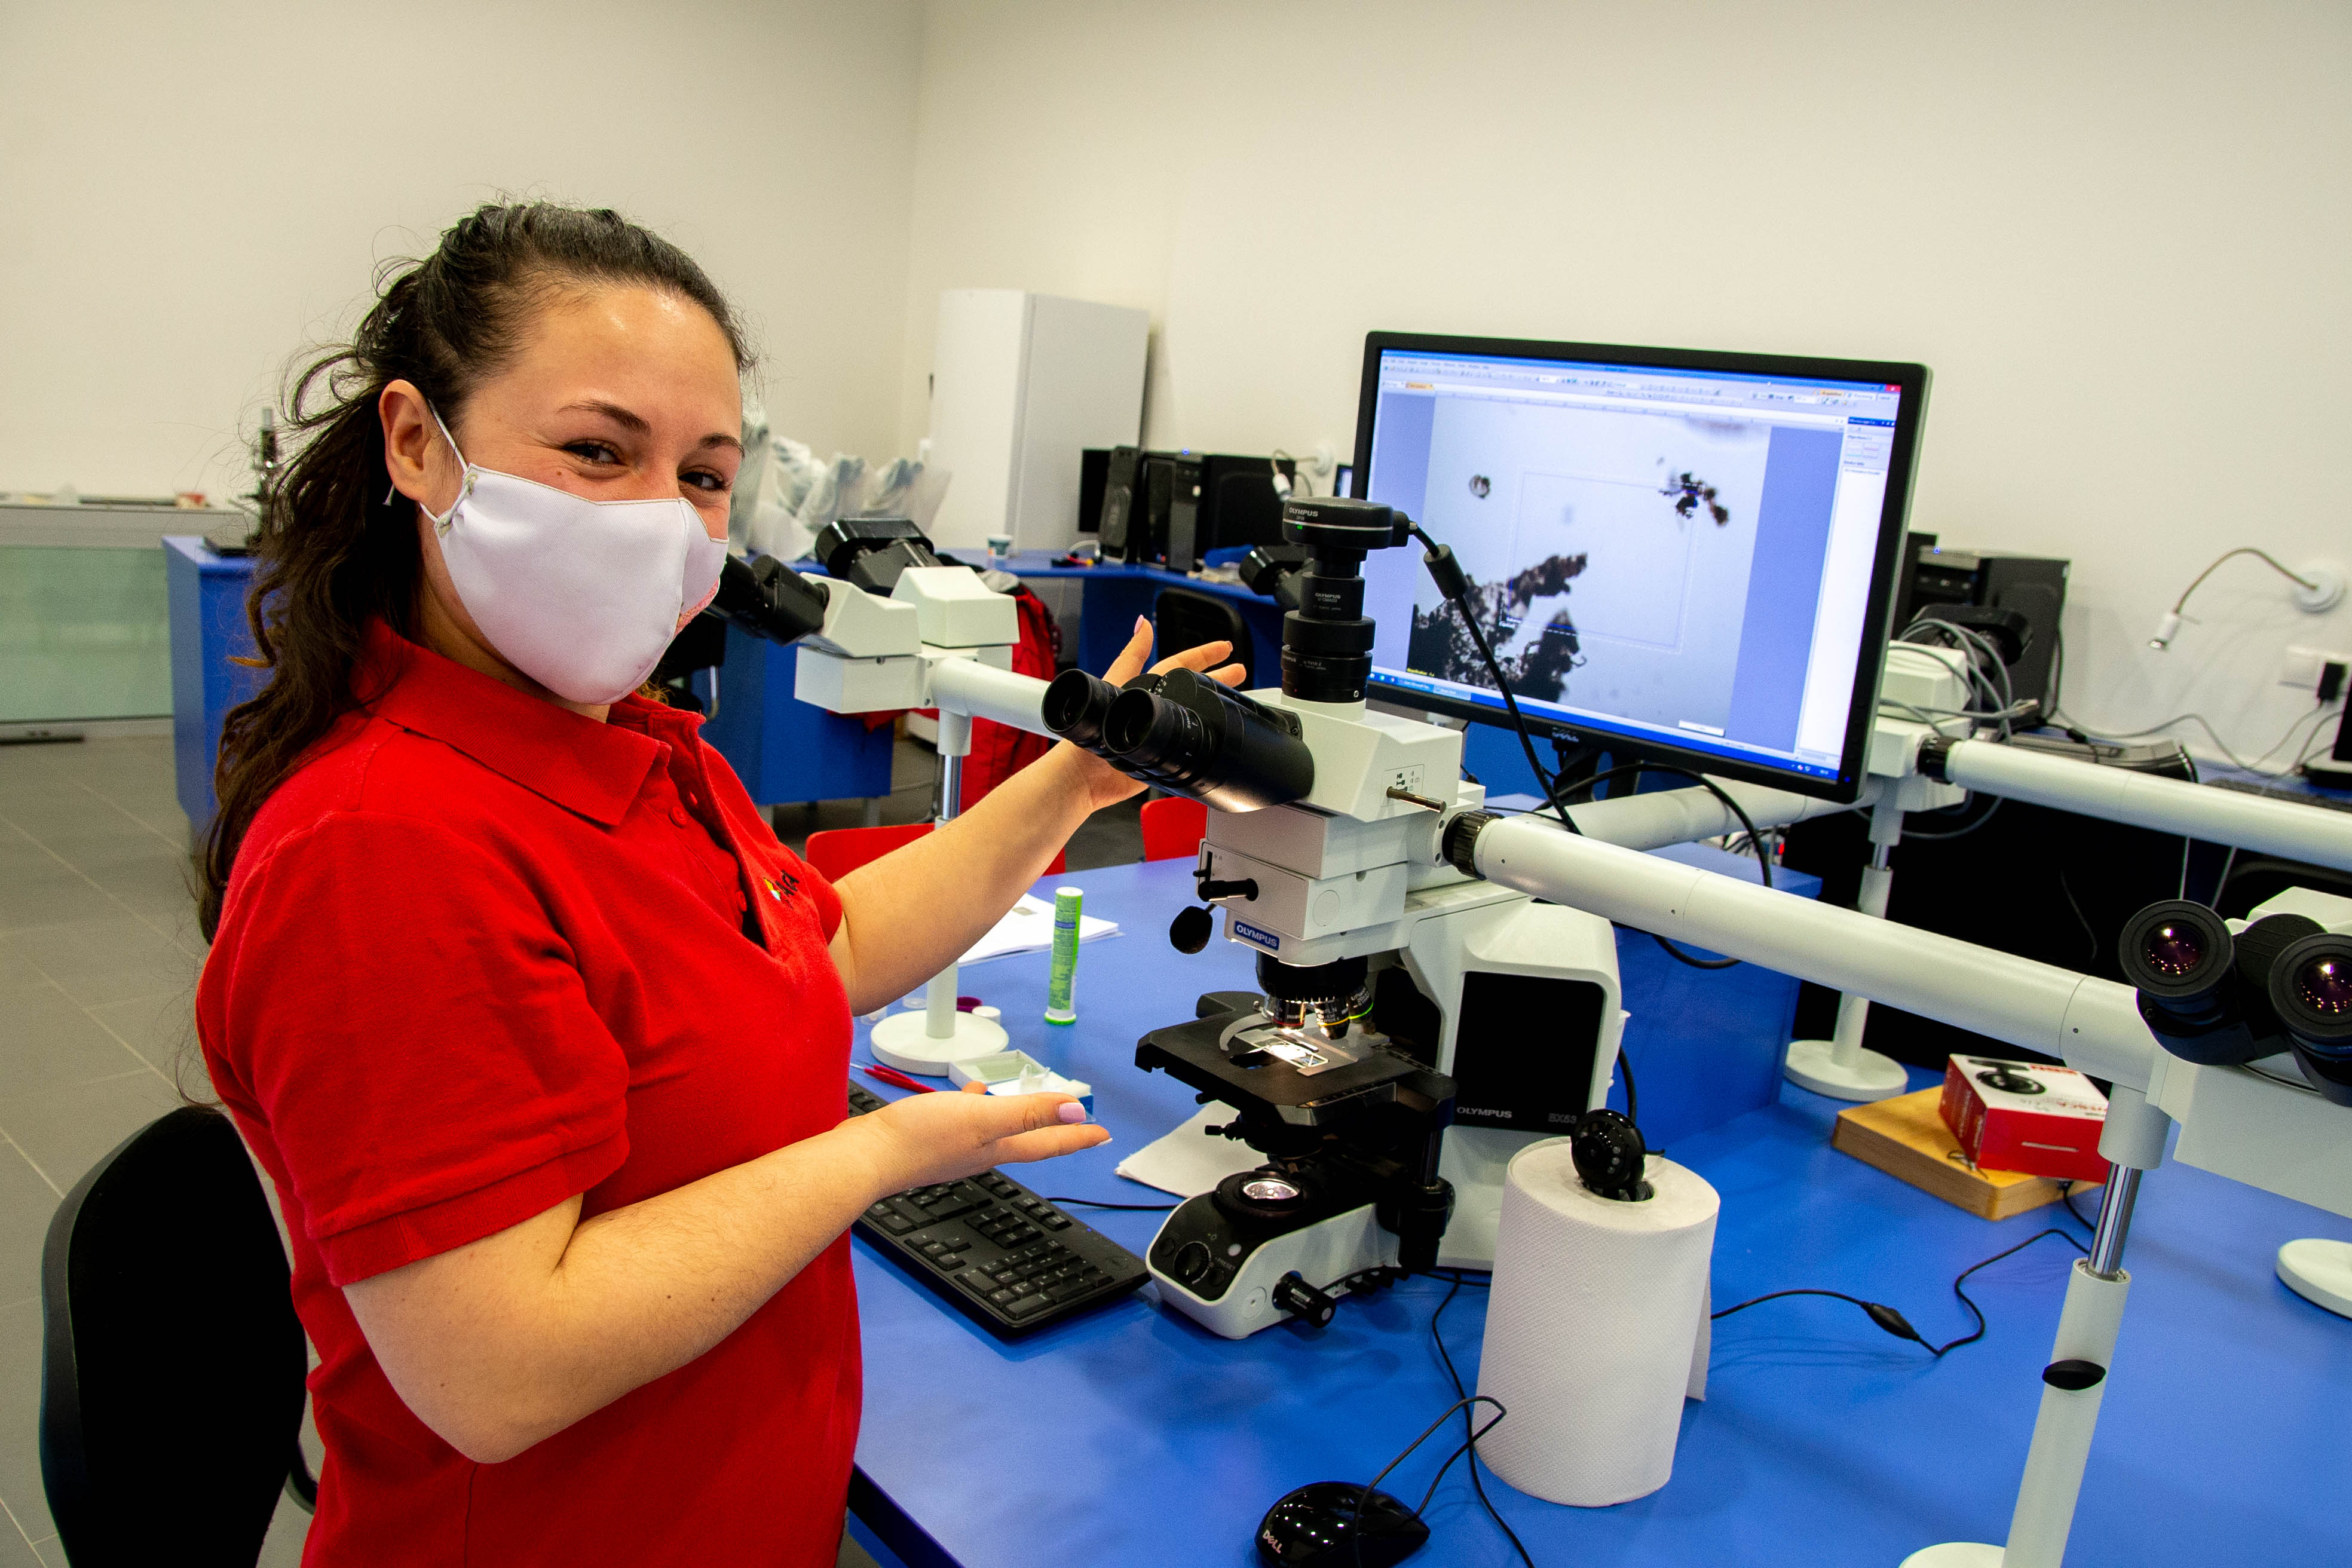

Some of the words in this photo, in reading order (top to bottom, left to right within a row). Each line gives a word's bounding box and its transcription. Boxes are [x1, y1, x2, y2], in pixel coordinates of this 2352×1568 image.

[1289, 507, 1318, 517] OLYMPUS
[1236, 924, 1277, 947] OLYMPUS
[1457, 1107, 1512, 1119] OLYMPUS
[1262, 1529, 1282, 1554] DELL
